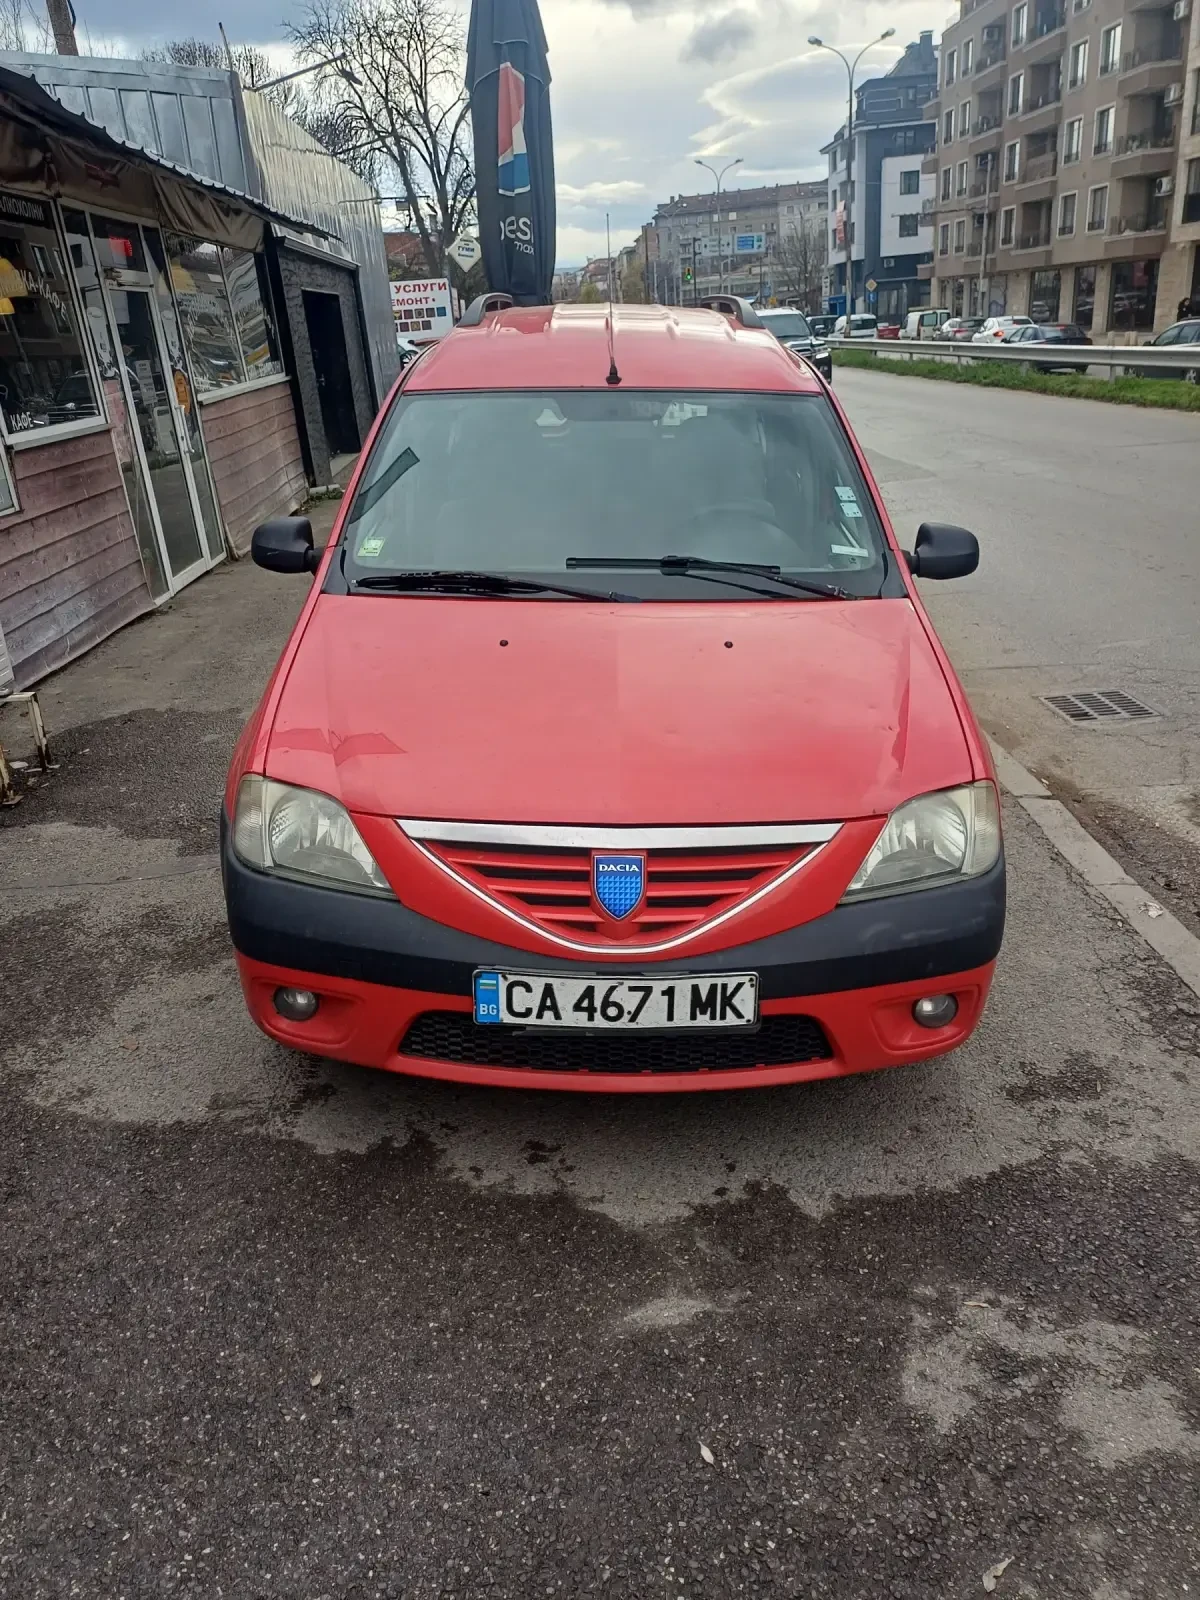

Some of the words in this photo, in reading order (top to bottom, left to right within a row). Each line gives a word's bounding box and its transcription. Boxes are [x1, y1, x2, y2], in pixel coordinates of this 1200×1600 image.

[394, 281, 447, 294] УСЛУГИ
[10, 411, 34, 431] КАФЕ
[598, 863, 640, 872] DACIA
[479, 1003, 497, 1015] BG
[572, 984, 676, 1023] 4671
